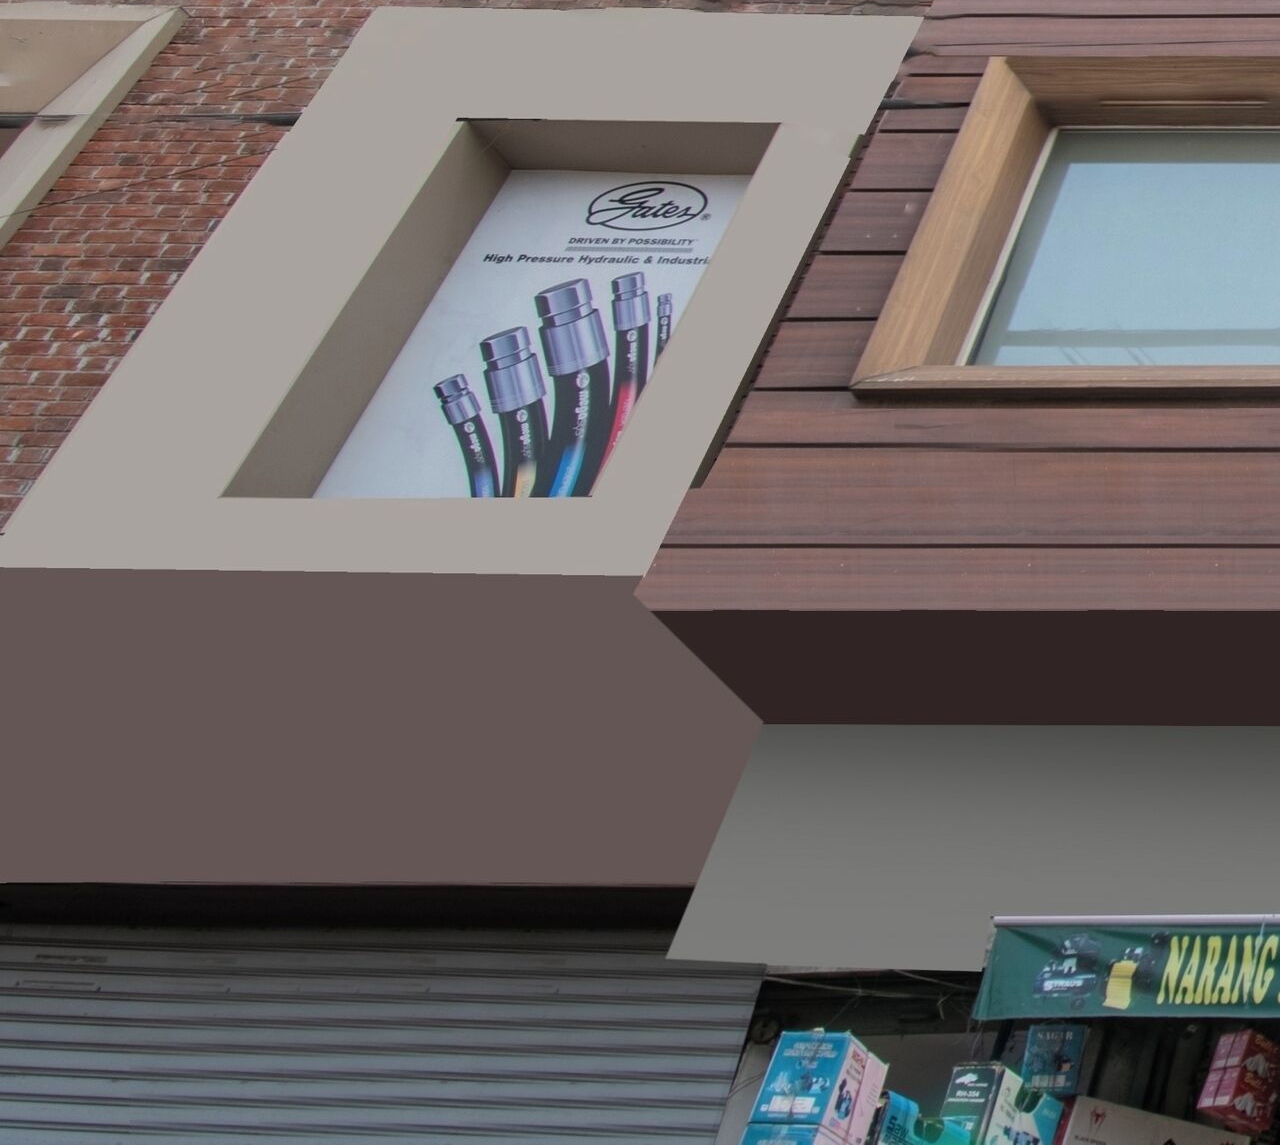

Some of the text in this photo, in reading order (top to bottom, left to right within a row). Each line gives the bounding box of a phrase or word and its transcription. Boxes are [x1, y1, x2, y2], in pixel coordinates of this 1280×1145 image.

[568, 237, 695, 246] DRIVEN BY POSSIBILITY
[483, 254, 710, 265] High Pressure Hydraulic & Industri
[1156, 934, 1279, 1005] NARANG
